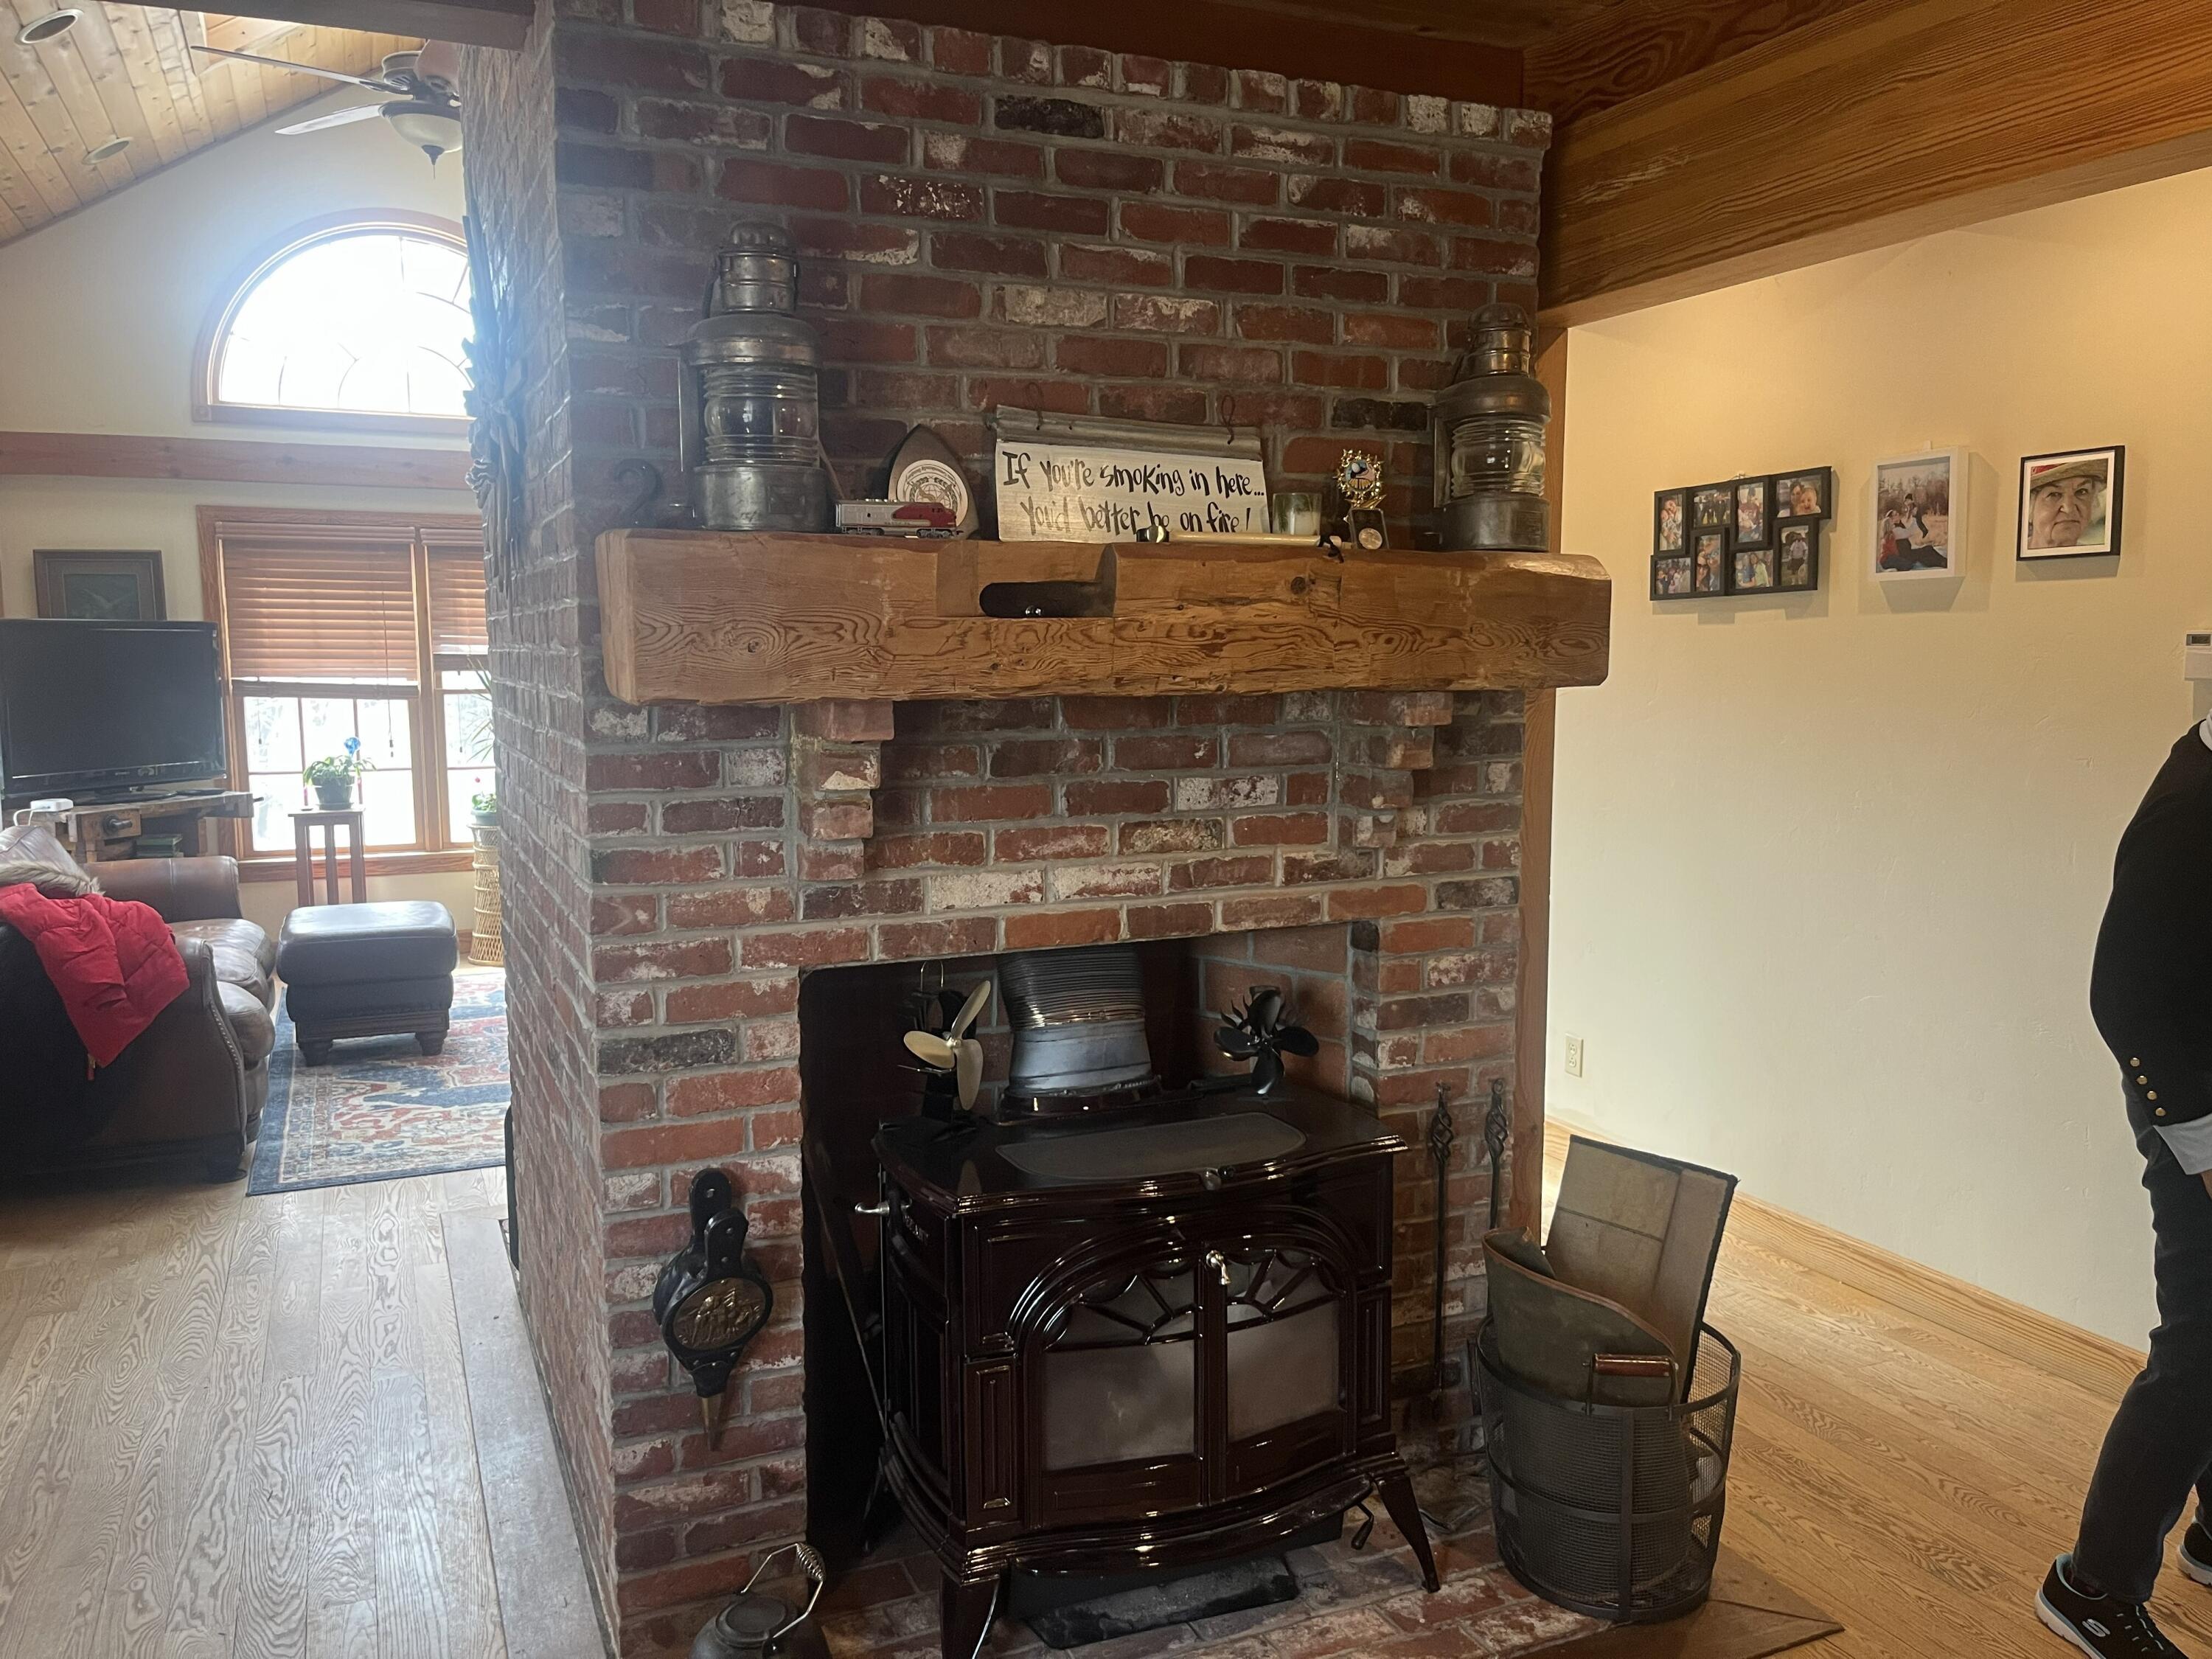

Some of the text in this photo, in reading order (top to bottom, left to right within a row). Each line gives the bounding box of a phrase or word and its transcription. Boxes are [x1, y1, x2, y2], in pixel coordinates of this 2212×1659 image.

[1001, 451, 1032, 490] If
[1189, 468, 1211, 496] in
[1215, 465, 1265, 498] here...
[1020, 495, 1071, 536] You'd
[1078, 496, 1141, 536] better
[1147, 501, 1170, 529] be
[1180, 511, 1203, 532] on
